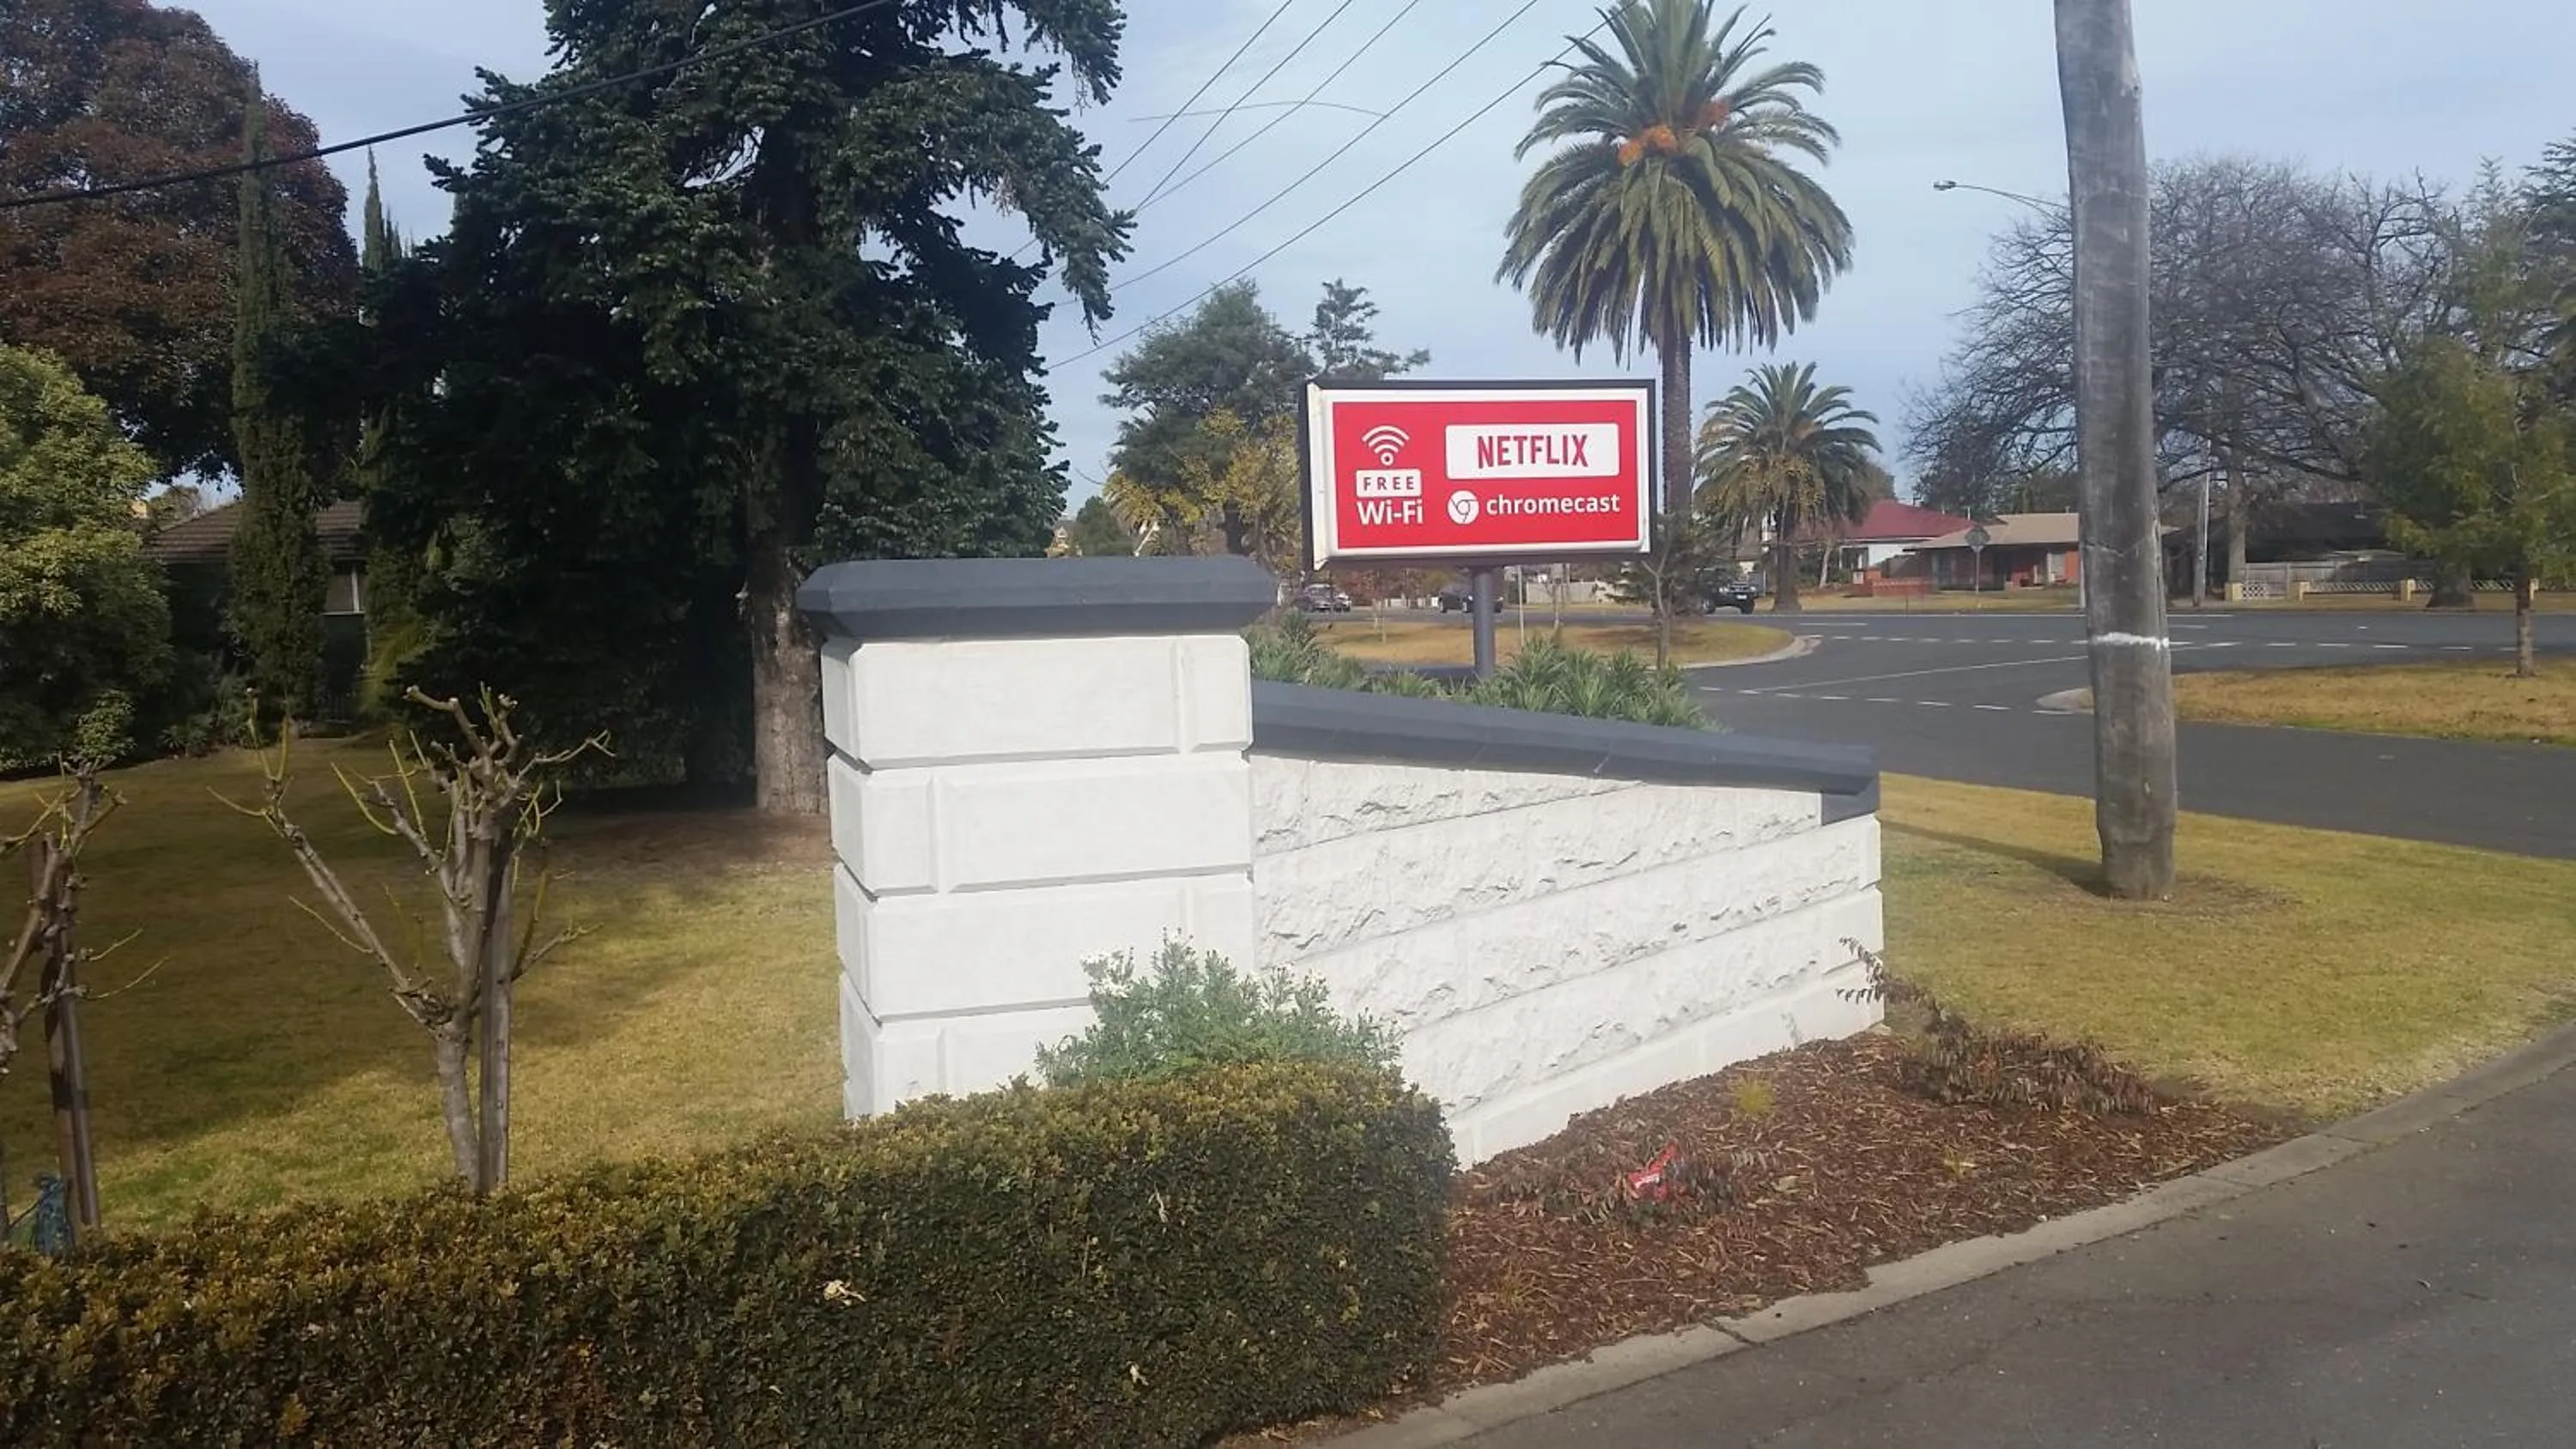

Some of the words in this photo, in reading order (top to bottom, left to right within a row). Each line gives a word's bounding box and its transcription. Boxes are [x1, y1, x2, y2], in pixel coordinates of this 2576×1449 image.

[1477, 434, 1589, 469] NETFLIX
[1363, 476, 1416, 490] FREE
[1357, 500, 1424, 524] Wi-Fi
[1485, 494, 1620, 516] chromecast
